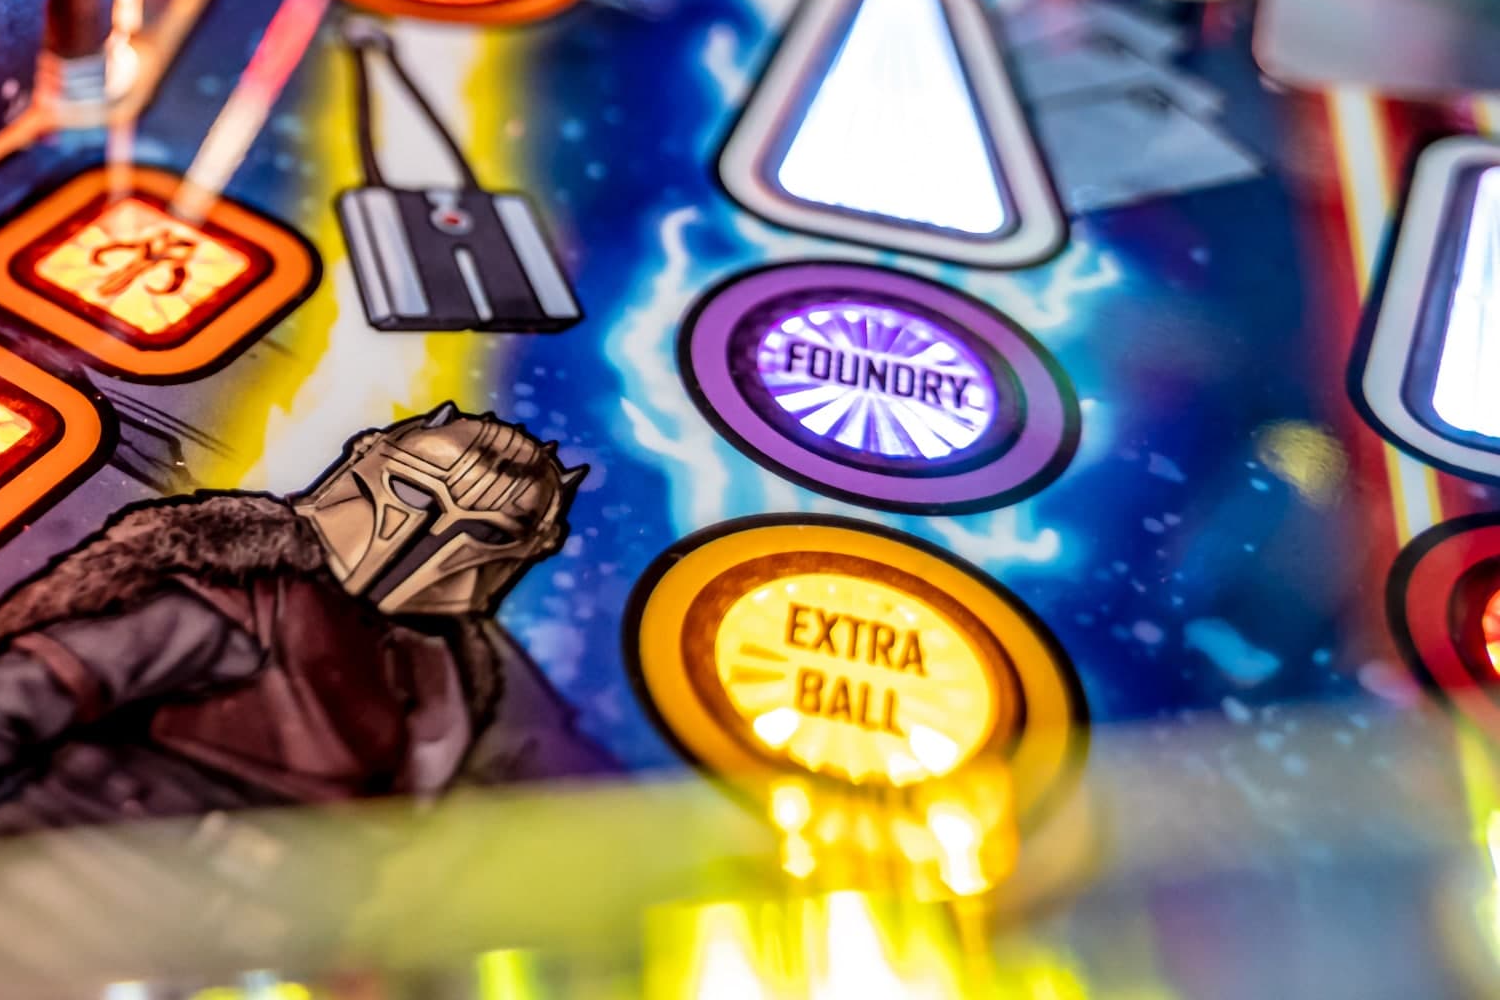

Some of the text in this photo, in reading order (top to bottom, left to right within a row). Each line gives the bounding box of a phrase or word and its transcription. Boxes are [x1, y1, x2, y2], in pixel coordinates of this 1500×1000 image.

[784, 340, 974, 409] FOUNDRY
[783, 600, 928, 677] EXTRA
[793, 667, 906, 737] BALL
